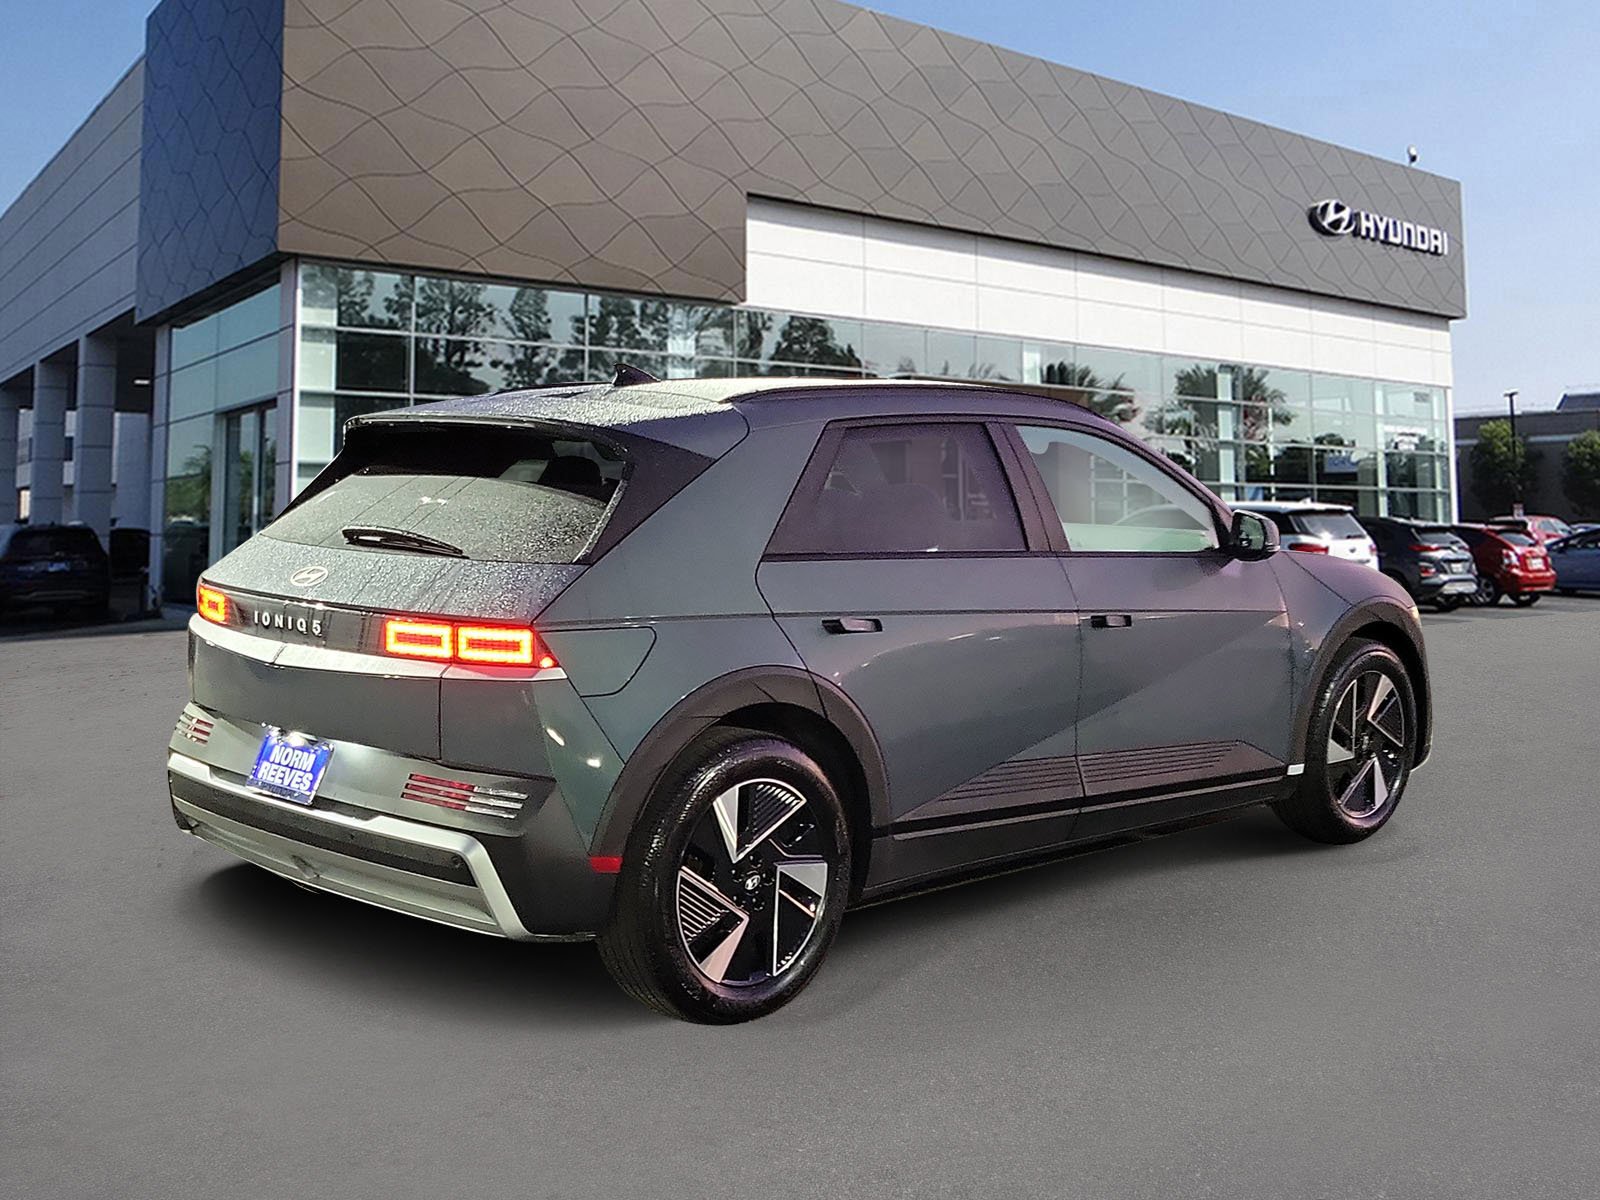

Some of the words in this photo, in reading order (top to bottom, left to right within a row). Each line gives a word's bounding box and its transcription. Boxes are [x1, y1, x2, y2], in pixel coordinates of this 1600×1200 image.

[1360, 210, 1448, 255] HYUNDAI
[269, 745, 317, 772] NORM
[257, 761, 314, 791] REEVES
